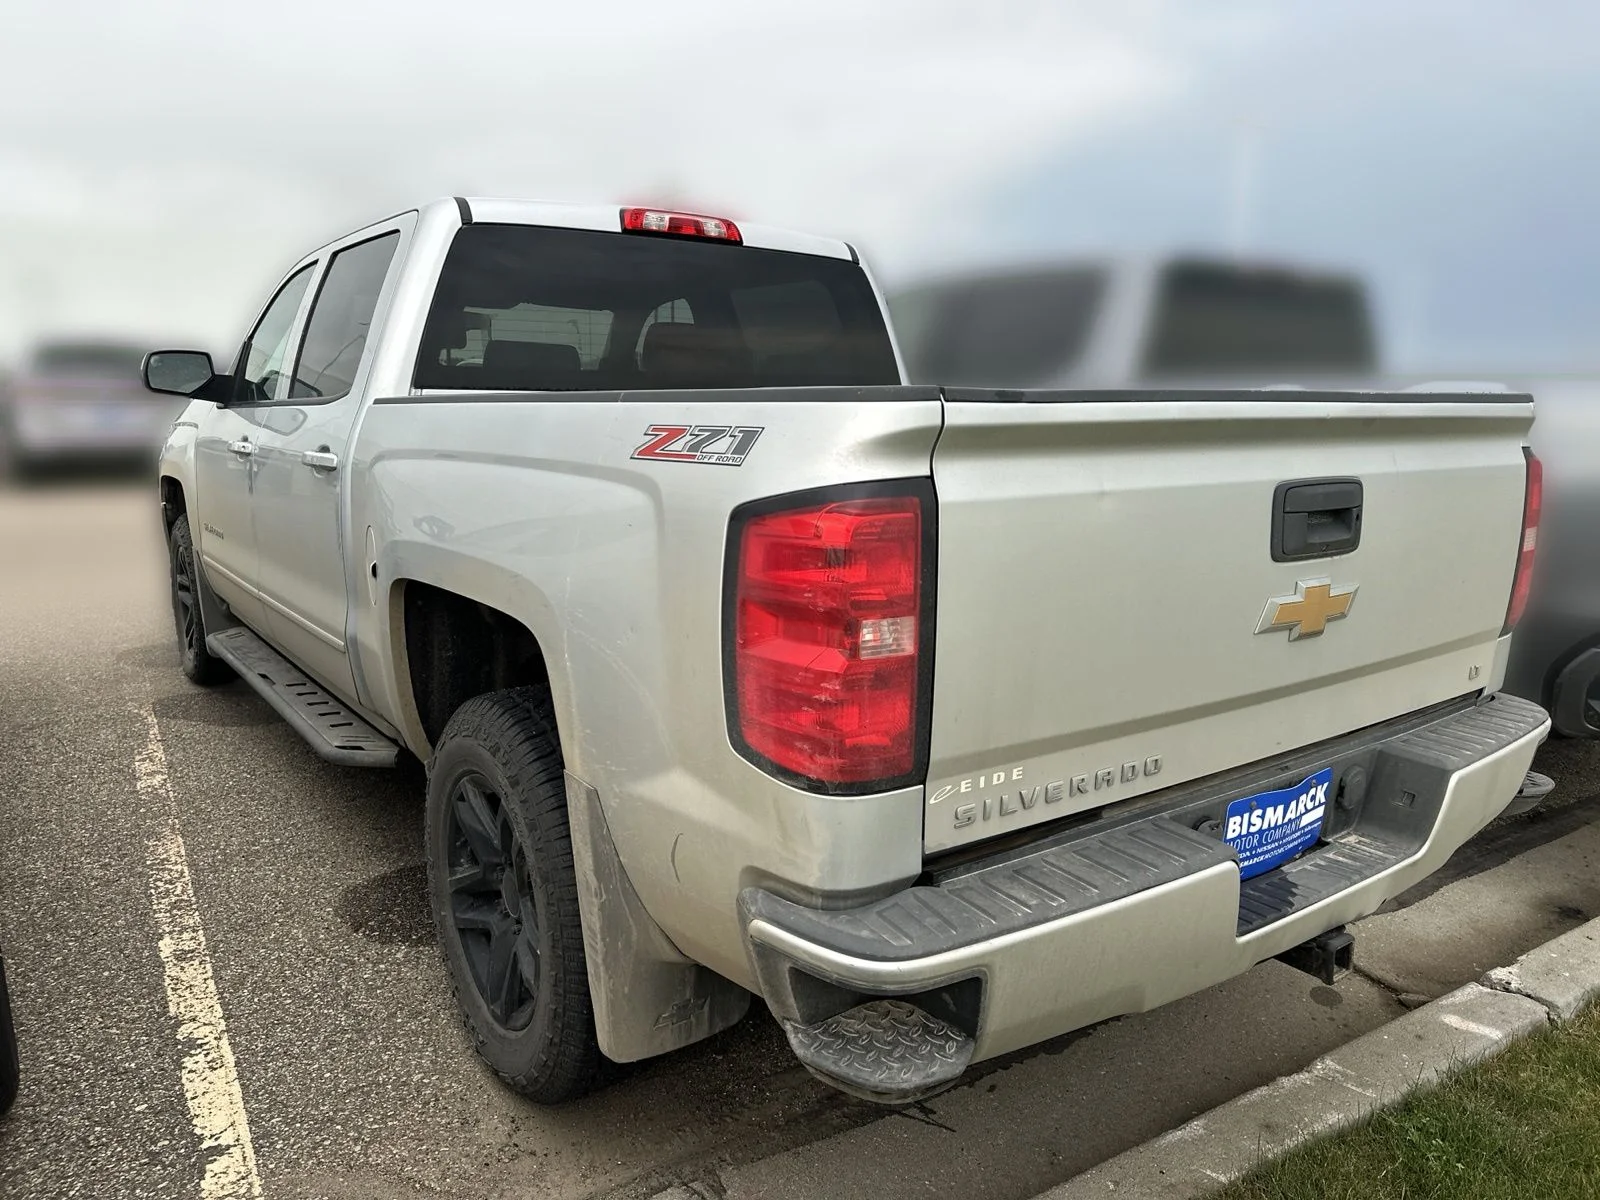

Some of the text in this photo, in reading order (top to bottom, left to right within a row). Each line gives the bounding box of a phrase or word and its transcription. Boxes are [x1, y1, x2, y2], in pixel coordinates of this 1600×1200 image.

[630, 425, 765, 466] Z71
[697, 454, 742, 463] OFF ROAD
[953, 754, 1163, 830] SILVERADO
[960, 766, 1024, 793] EIDE
[1226, 782, 1329, 840] BISMARCK
[1262, 818, 1301, 844] COMPANY
